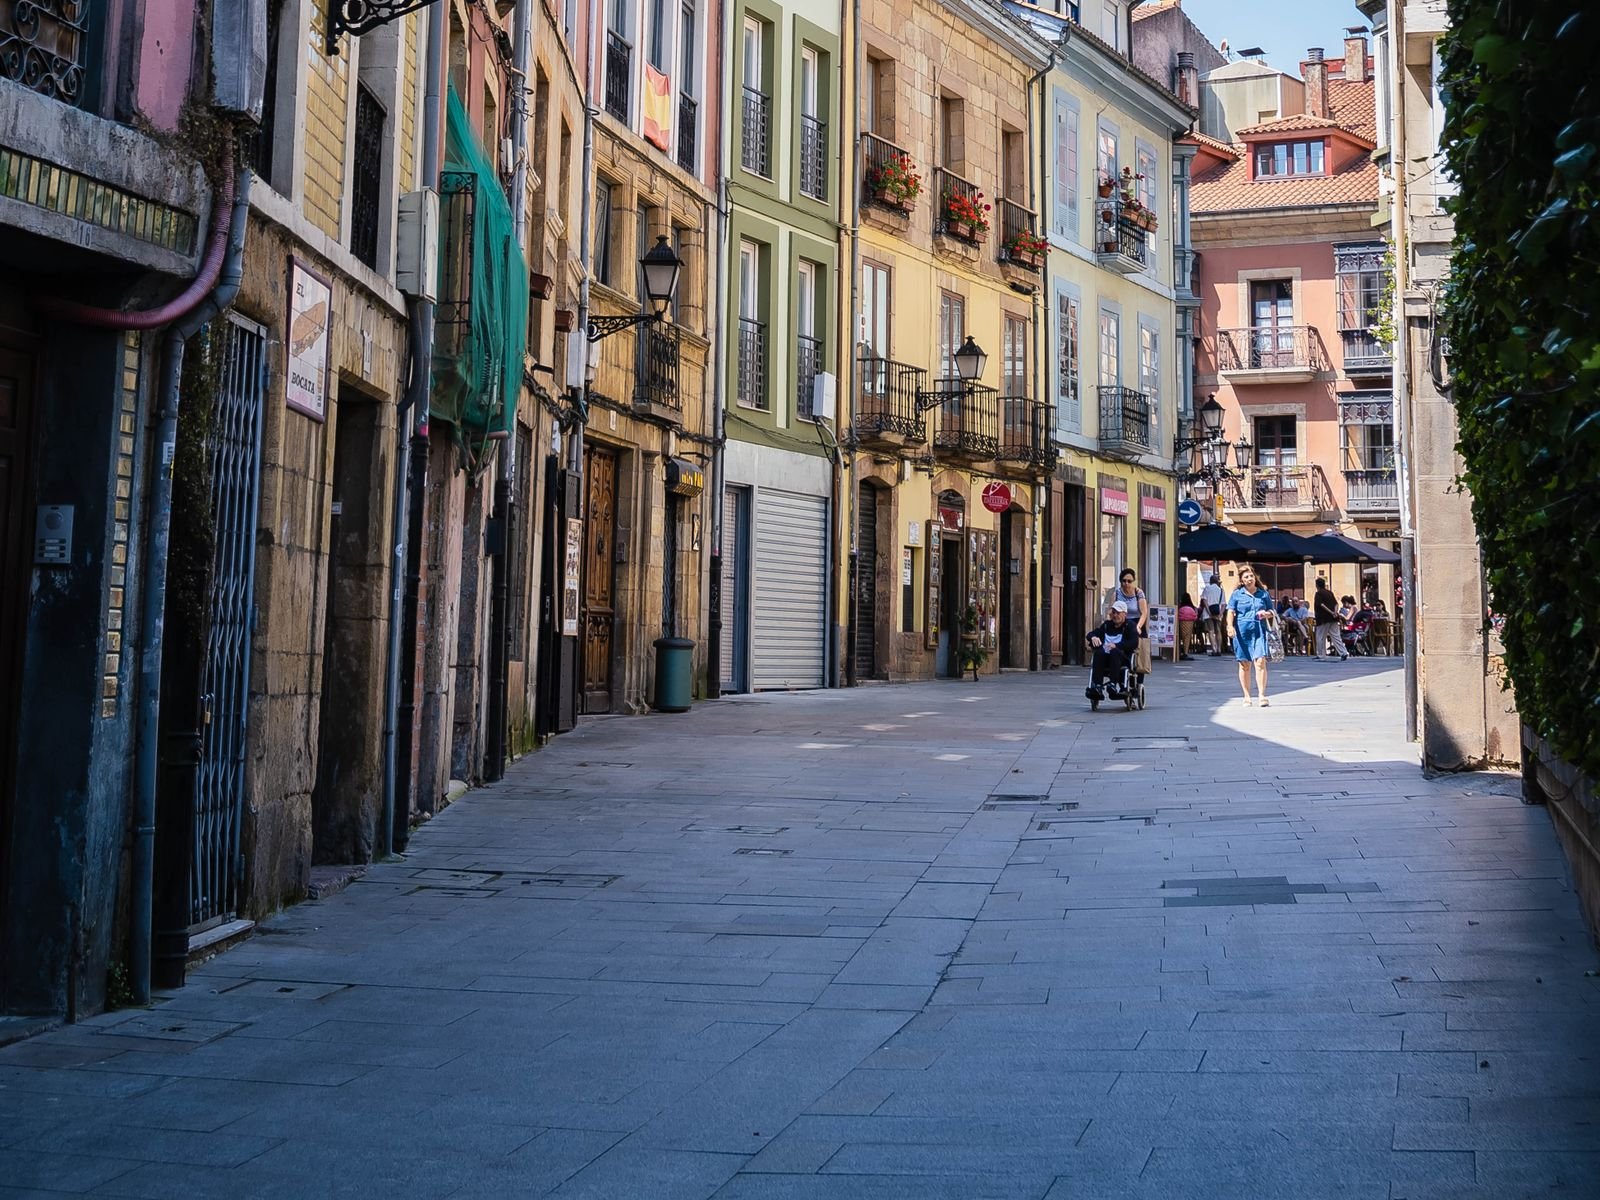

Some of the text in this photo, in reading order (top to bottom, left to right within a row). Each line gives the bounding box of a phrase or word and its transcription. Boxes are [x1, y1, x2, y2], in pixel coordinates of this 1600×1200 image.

[80, 224, 91, 246] 16
[296, 282, 305, 298] EL
[291, 371, 315, 395] BOCATA
